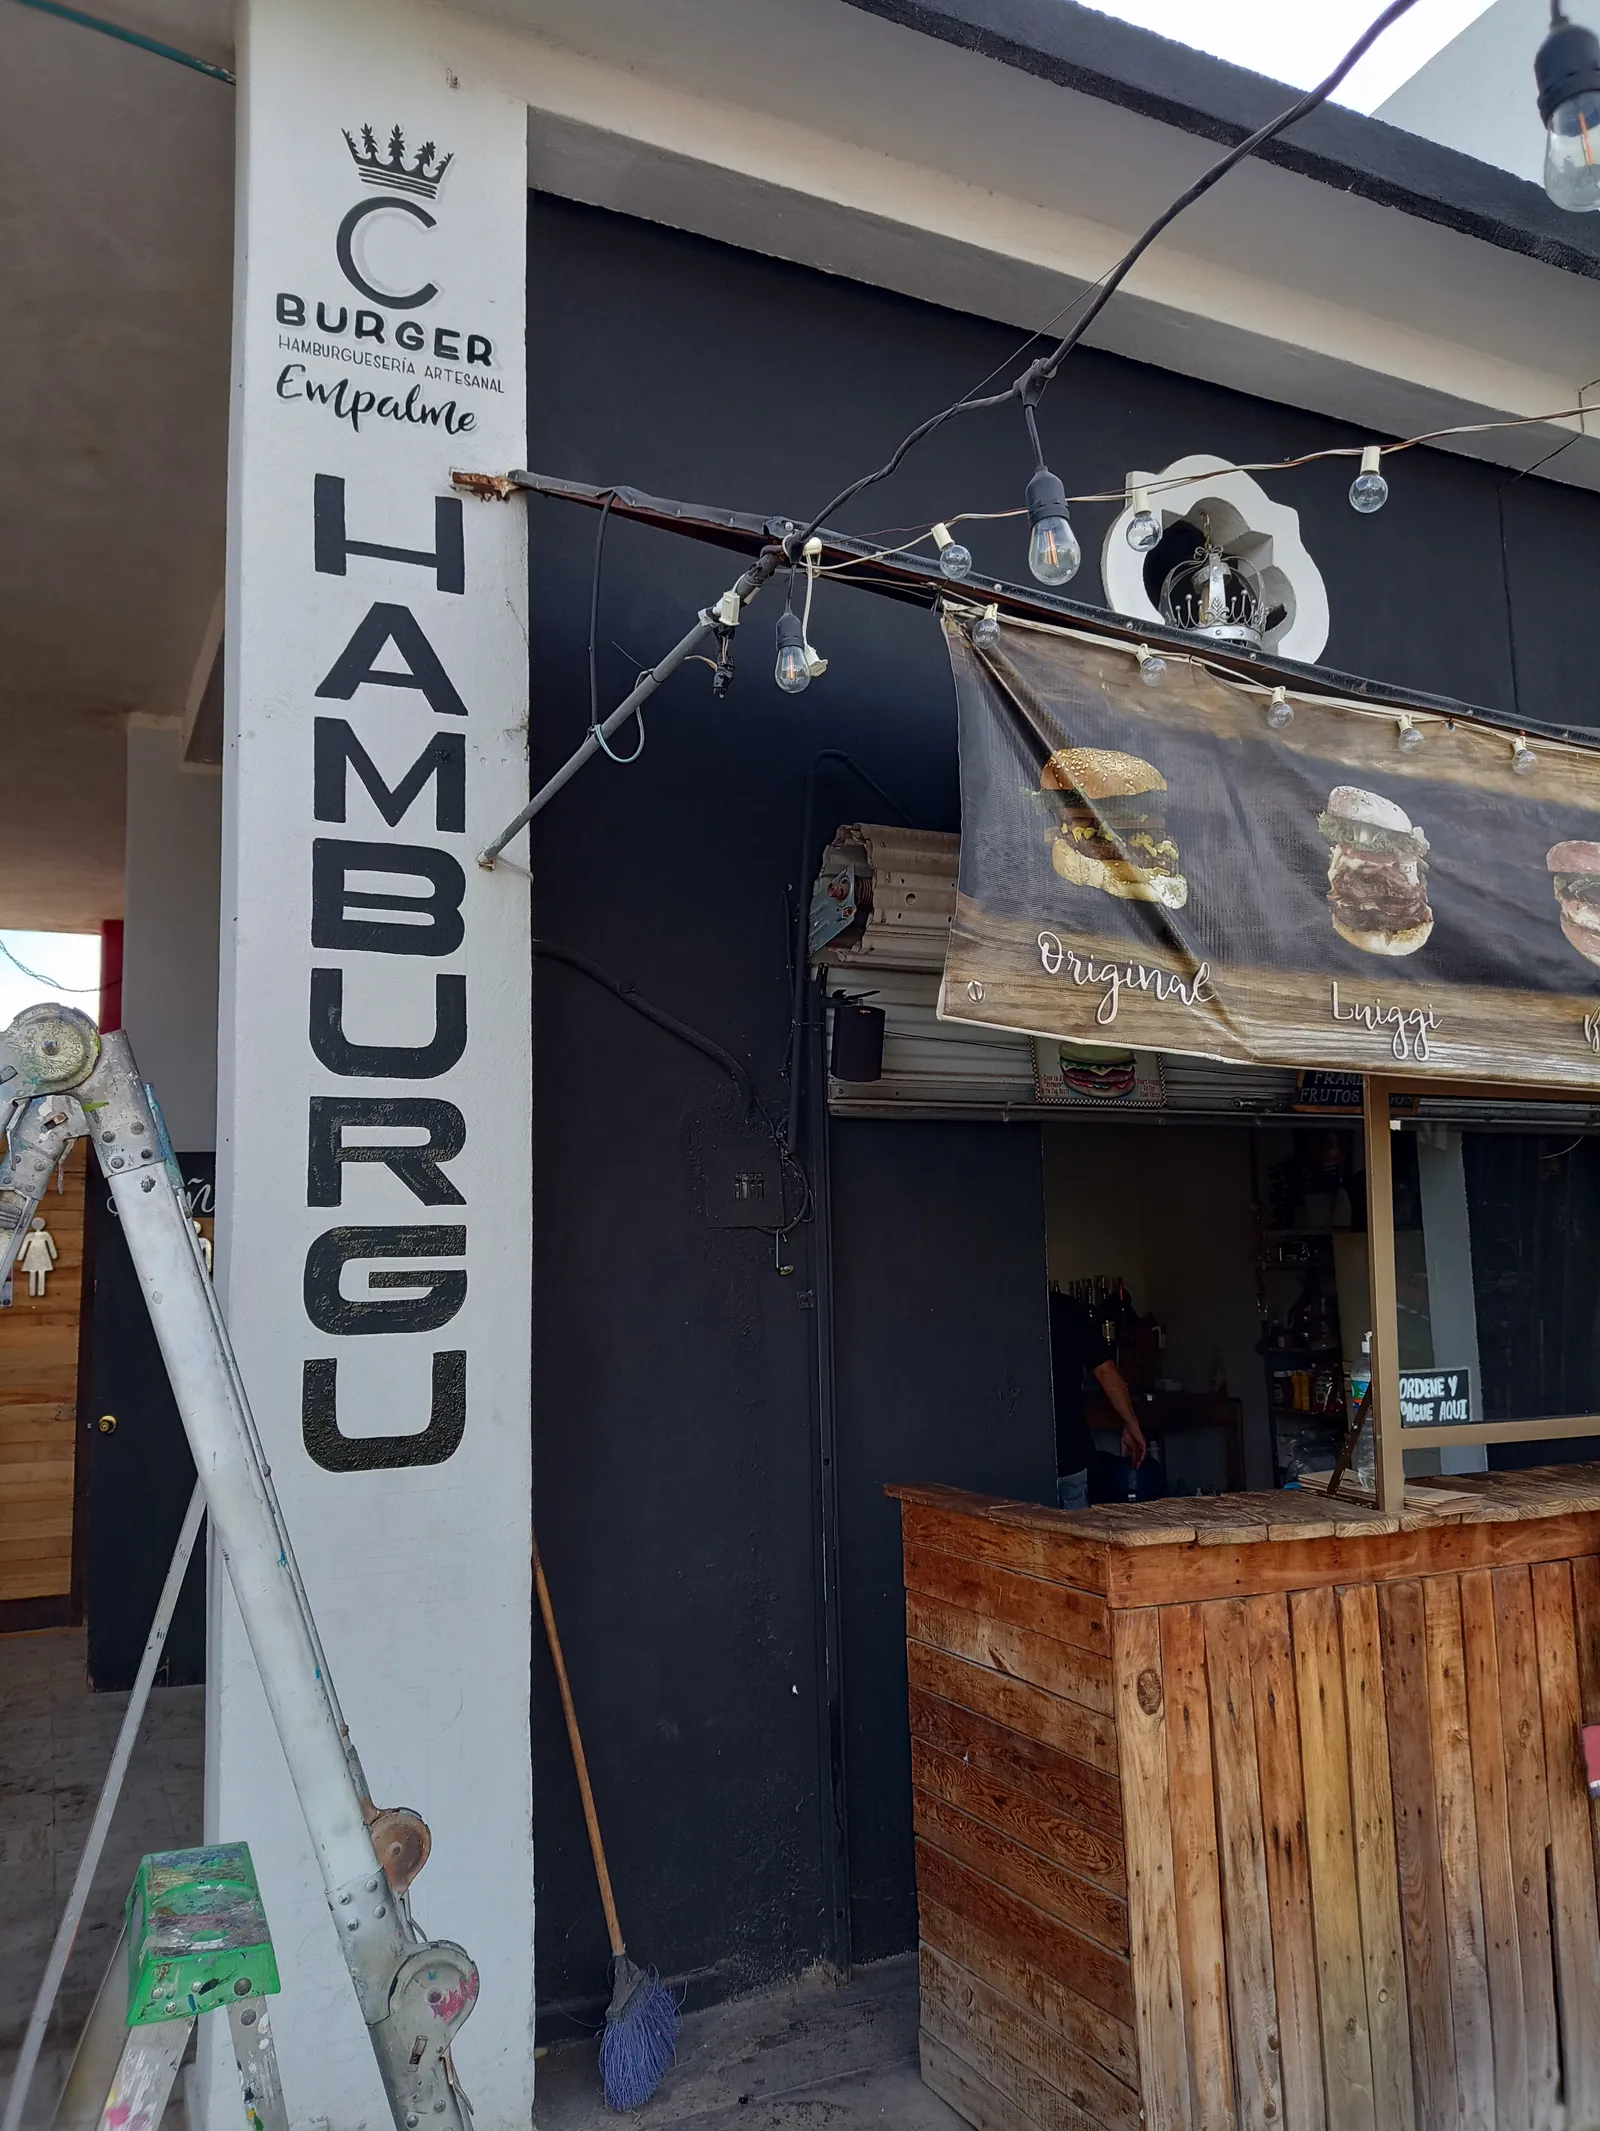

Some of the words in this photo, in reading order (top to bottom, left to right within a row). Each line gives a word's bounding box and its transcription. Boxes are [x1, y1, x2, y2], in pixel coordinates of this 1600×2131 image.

[336, 196, 439, 310] C
[276, 292, 493, 367] BURGER
[278, 334, 416, 375] HAMBURGUESERÍA
[424, 366, 505, 394] ARTESANAL
[276, 363, 478, 435] Empalme
[301, 472, 469, 1474] HAMBURGU
[1037, 931, 1216, 1025] Original
[1300, 1087, 1361, 1104] FRUTOS
[1399, 1376, 1446, 1400] ORDENE
[1447, 1375, 1458, 1397] Y
[1400, 1400, 1435, 1422] PAGUE
[1439, 1398, 1468, 1422] AQUI
